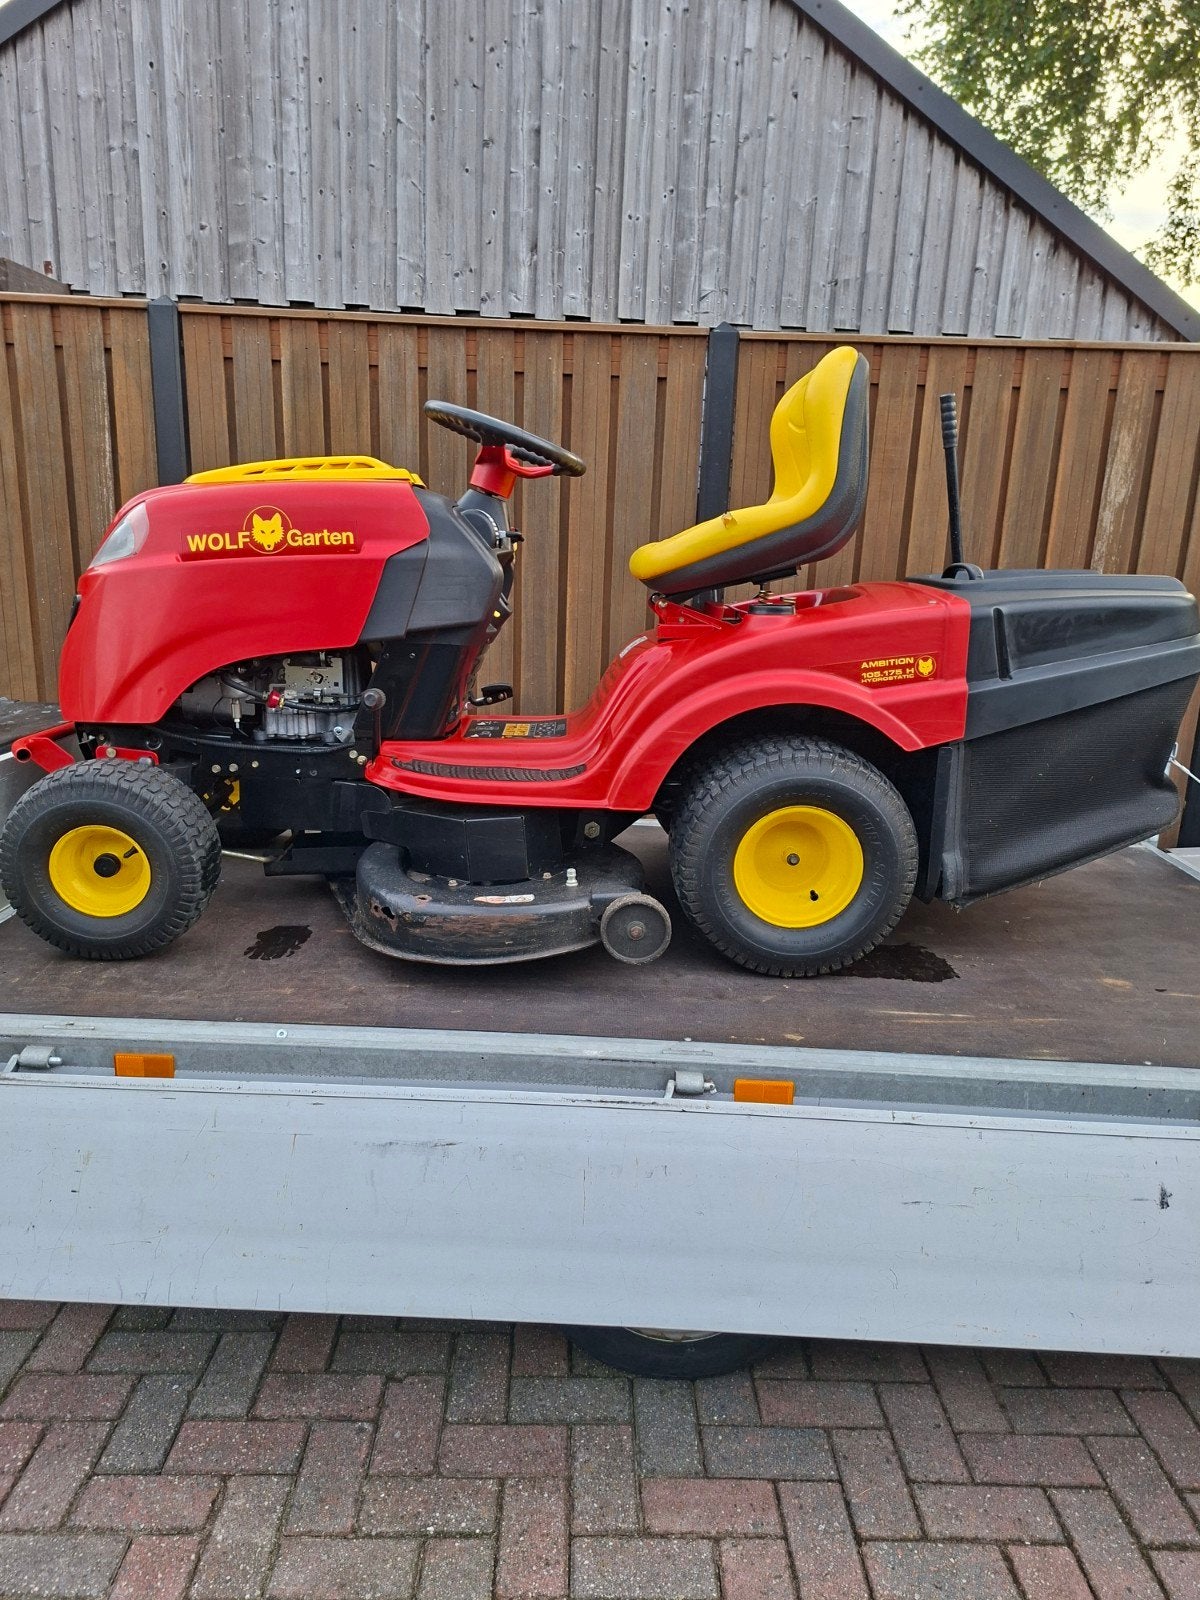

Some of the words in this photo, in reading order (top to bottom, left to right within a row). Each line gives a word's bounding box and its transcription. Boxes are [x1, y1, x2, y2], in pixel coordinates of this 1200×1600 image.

[187, 532, 250, 551] WOLF
[286, 529, 354, 546] Garten
[861, 657, 914, 669] AMBITION
[861, 669, 903, 679] 105.175
[861, 674, 914, 683] HYDROSTATIC
